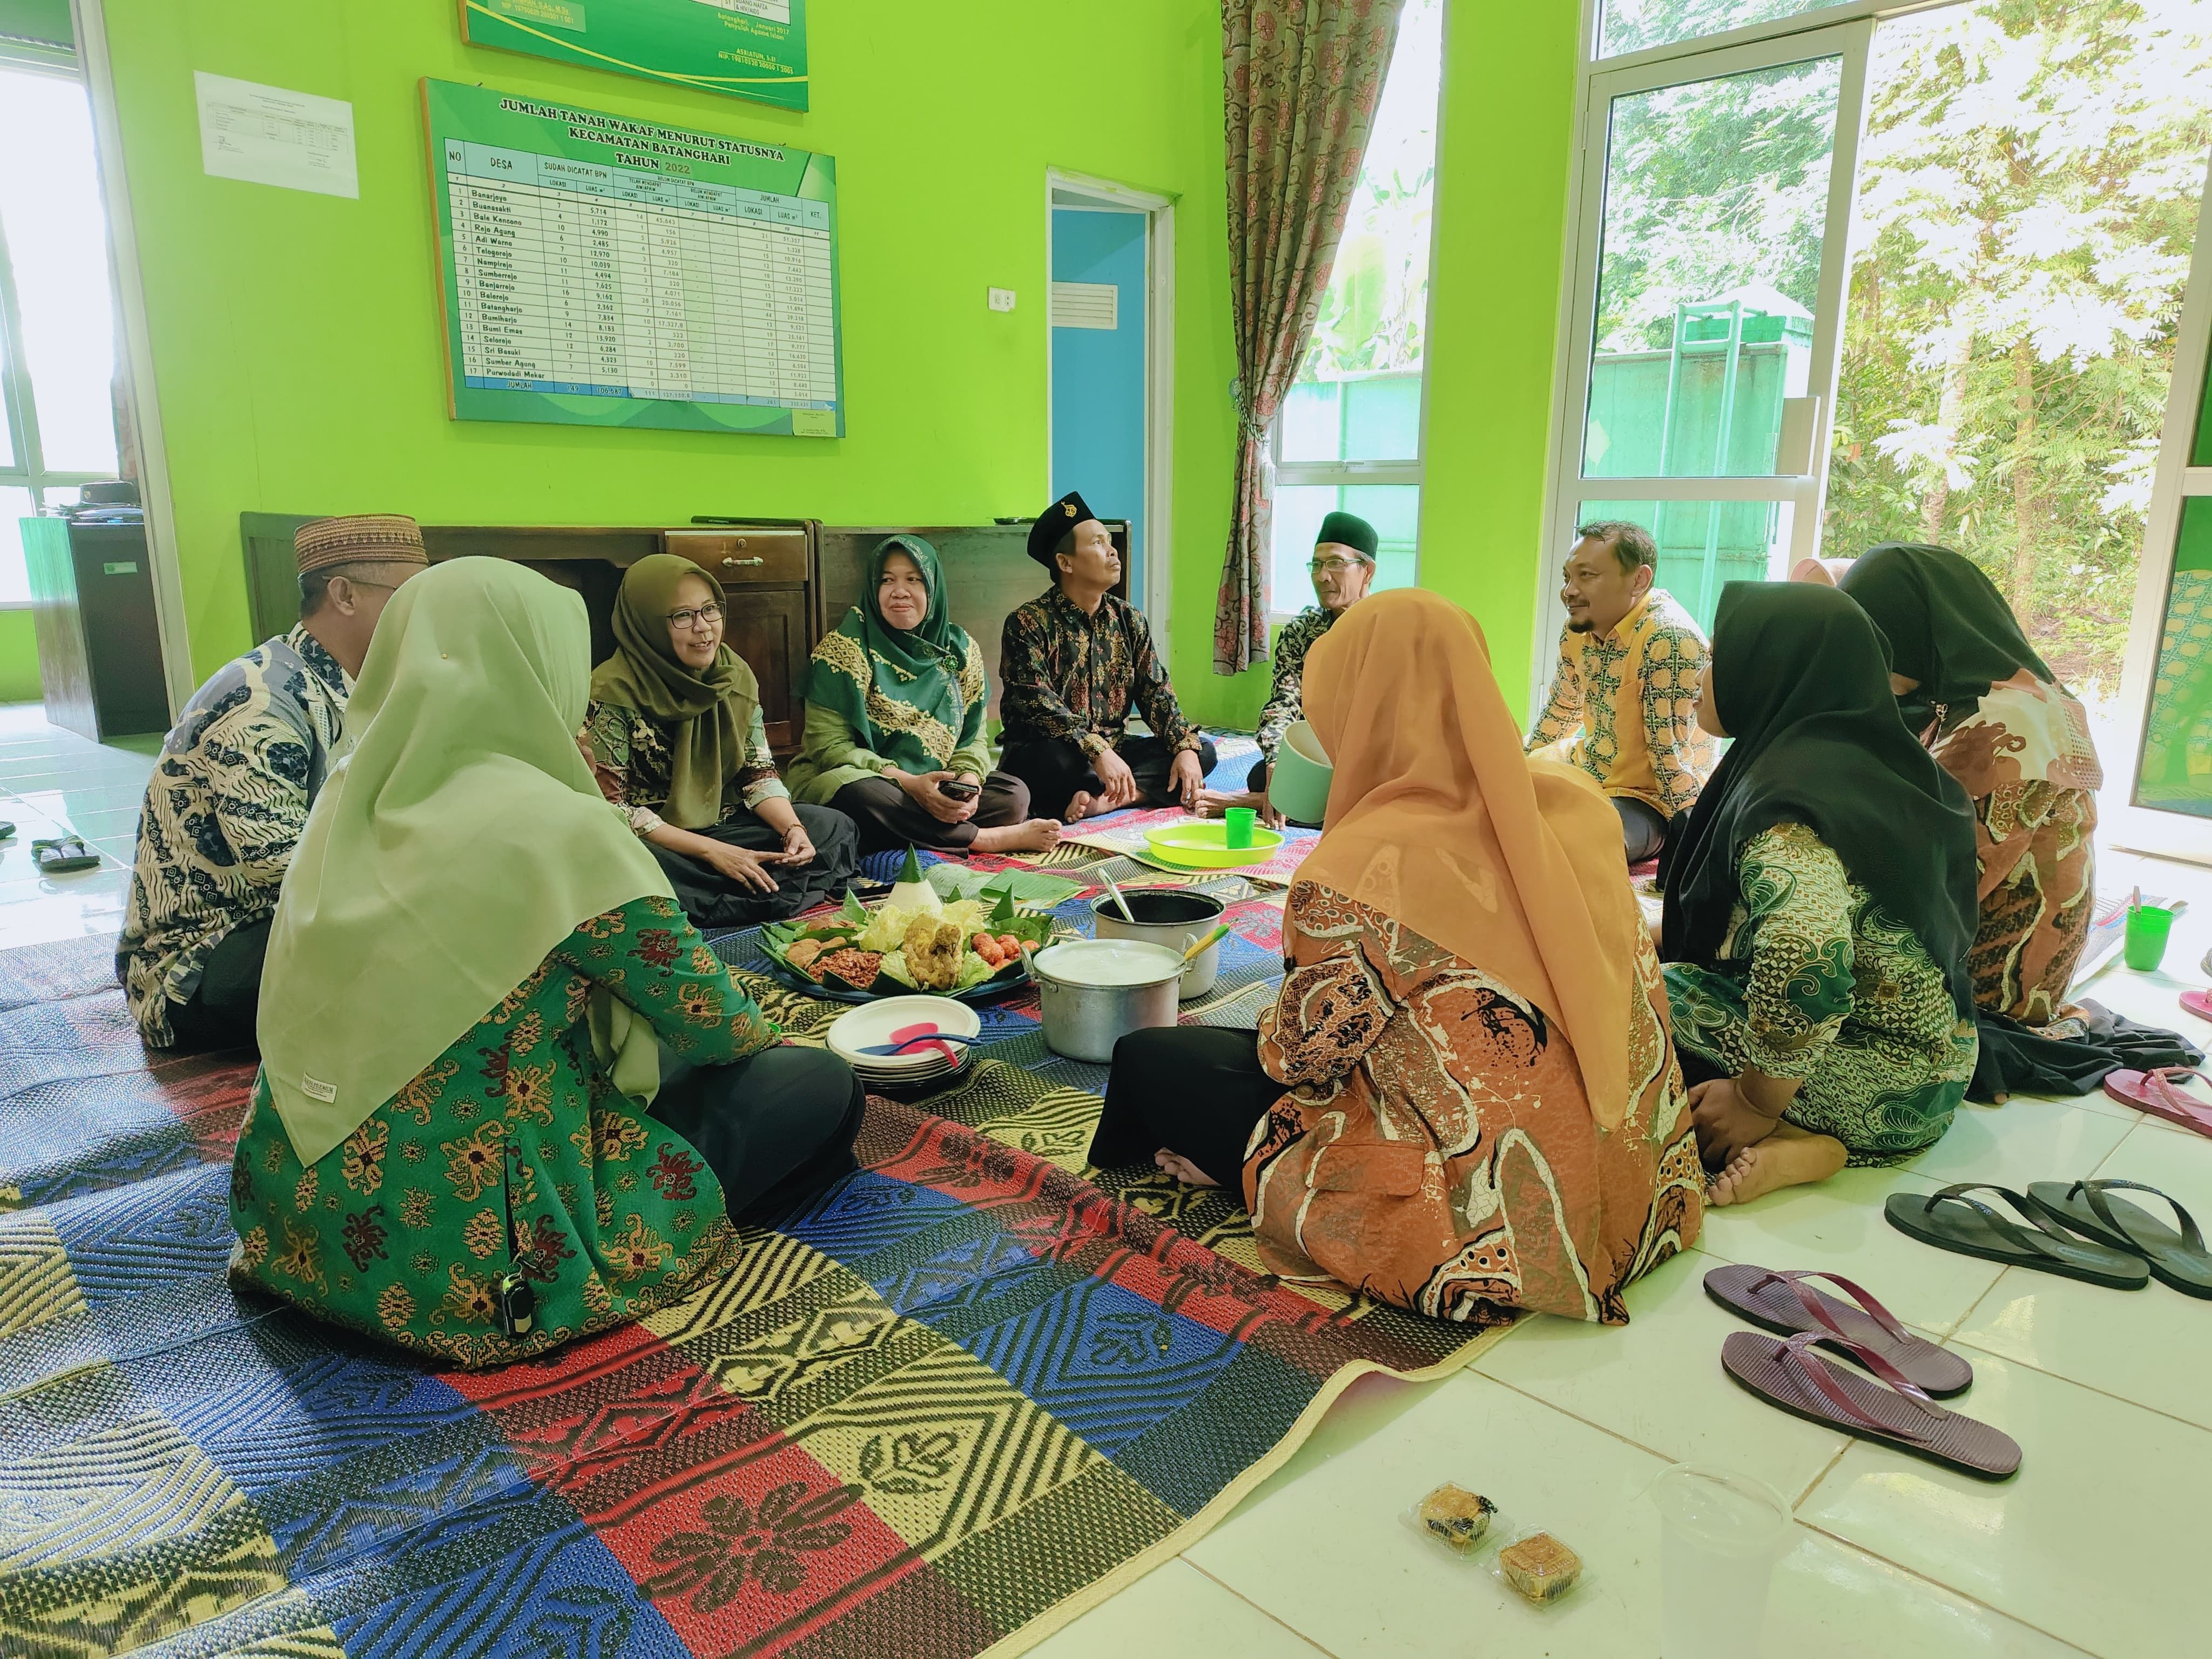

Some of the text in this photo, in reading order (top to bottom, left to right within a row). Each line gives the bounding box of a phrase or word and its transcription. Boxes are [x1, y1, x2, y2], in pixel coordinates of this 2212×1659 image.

[740, 6, 759, 15] HIV/AIDS
[753, 2, 767, 10] NAFZA
[756, 22, 775, 31] Januari
[737, 48, 765, 60] ASRIATUN,
[500, 99, 784, 161] JUMLAH TANAH WAKAF MENURUT STATUSNYA
[569, 127, 730, 165] KECAMATAN BATANGHARI
[449, 151, 462, 161] NO
[490, 157, 512, 170] DESA
[616, 153, 691, 175] TAHUN 2022
[544, 161, 607, 179] SUDAH DICATAT BPN
[549, 179, 567, 188] LOKASI
[471, 189, 507, 203] Banarjoyo
[590, 207, 607, 216] 5,714
[622, 191, 638, 199] LOKASI
[760, 194, 780, 204] JUMLAH
[472, 200, 511, 213] Buanasakti
[591, 218, 608, 226] 1,172
[744, 206, 763, 215] LOKASI
[777, 211, 791, 220] LUAS
[473, 212, 490, 221] Bale
[493, 215, 522, 226] Kencono
[591, 228, 609, 237] 4,990
[474, 224, 491, 234] Rejo
[493, 226, 516, 238] Agung
[592, 239, 609, 248] 2,485
[475, 235, 488, 244] Adi
[490, 237, 512, 247] Warno
[590, 250, 610, 258] 12,970
[462, 244, 467, 252] 6
[476, 246, 512, 259] Telogorejo
[591, 260, 611, 269] 10,039
[477, 258, 512, 268] Nampirejo
[595, 272, 611, 280] 4,494
[478, 268, 517, 281] Sumberrejo
[595, 282, 612, 290] 7,625
[478, 280, 515, 292] Banjarrejo
[596, 292, 613, 301] 9,162
[480, 291, 509, 302] Balerejo
[597, 303, 613, 311] 2,362
[481, 302, 523, 314] Batangharjo
[597, 314, 614, 322] 7,834
[481, 313, 517, 325] Bumiharjo
[598, 324, 615, 332] 8,183
[482, 324, 501, 333] Bumi
[503, 326, 523, 335] Emas
[596, 335, 616, 343] 13,920
[483, 335, 512, 346] Selorejo
[600, 345, 616, 353] 6,284
[497, 347, 521, 355] Basuki
[485, 357, 512, 366] Sumber
[514, 359, 536, 369] Agung
[486, 368, 522, 377] Purwodadi
[524, 370, 545, 379] Mekar
[507, 381, 532, 389] JUMLAH
[568, 384, 579, 393] 149
